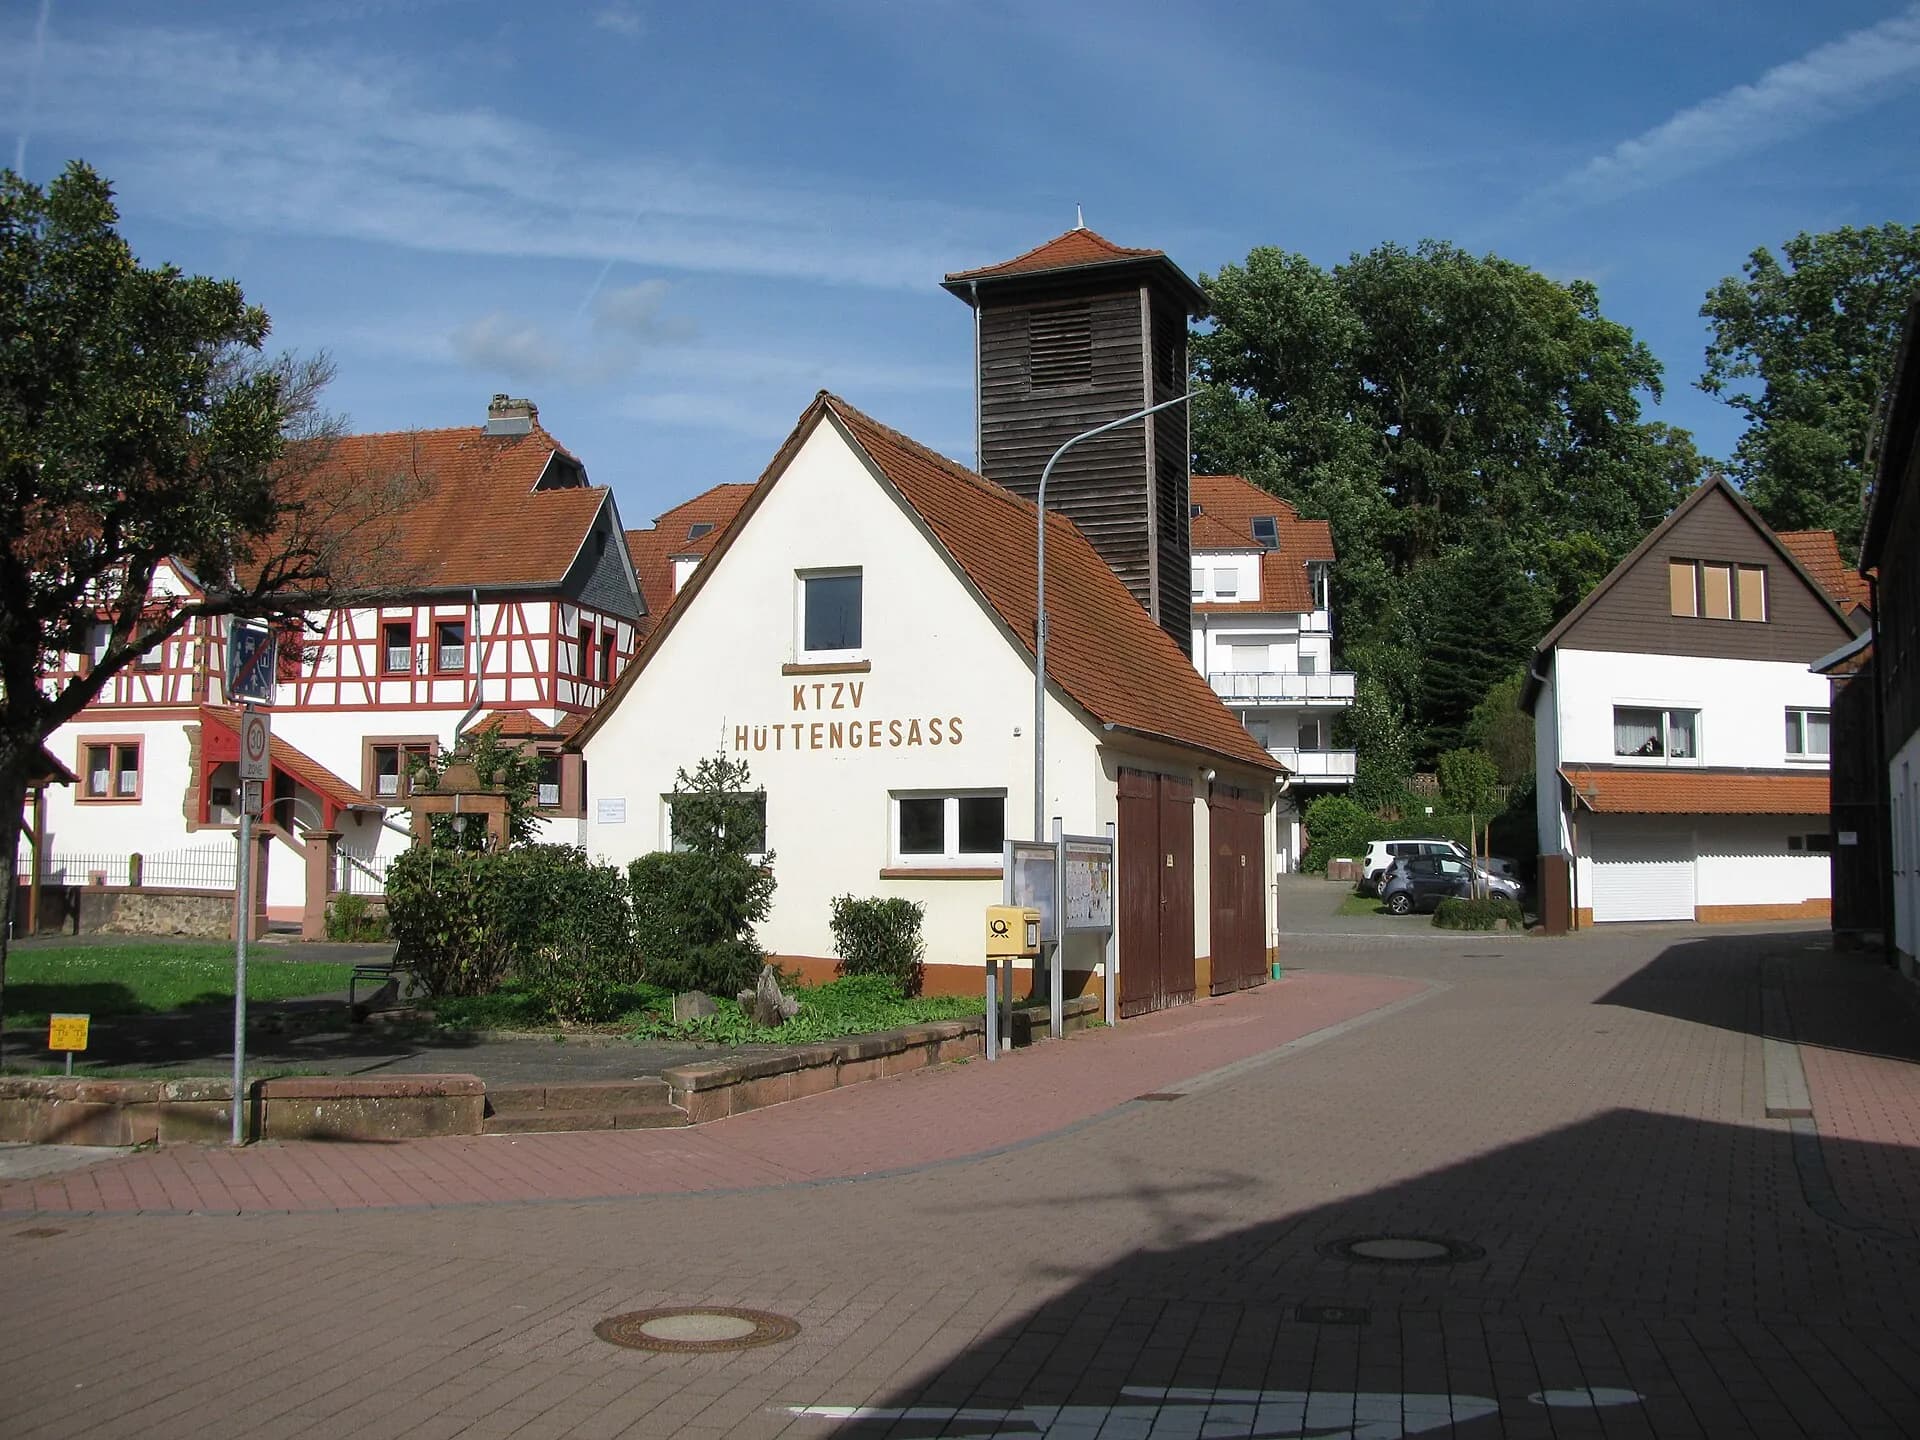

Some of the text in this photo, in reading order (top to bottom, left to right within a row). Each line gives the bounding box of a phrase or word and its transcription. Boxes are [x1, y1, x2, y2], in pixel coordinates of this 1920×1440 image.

[793, 682, 864, 711] KTZV
[250, 729, 261, 750] 30
[735, 717, 963, 751] HÜTTENGESÄSS
